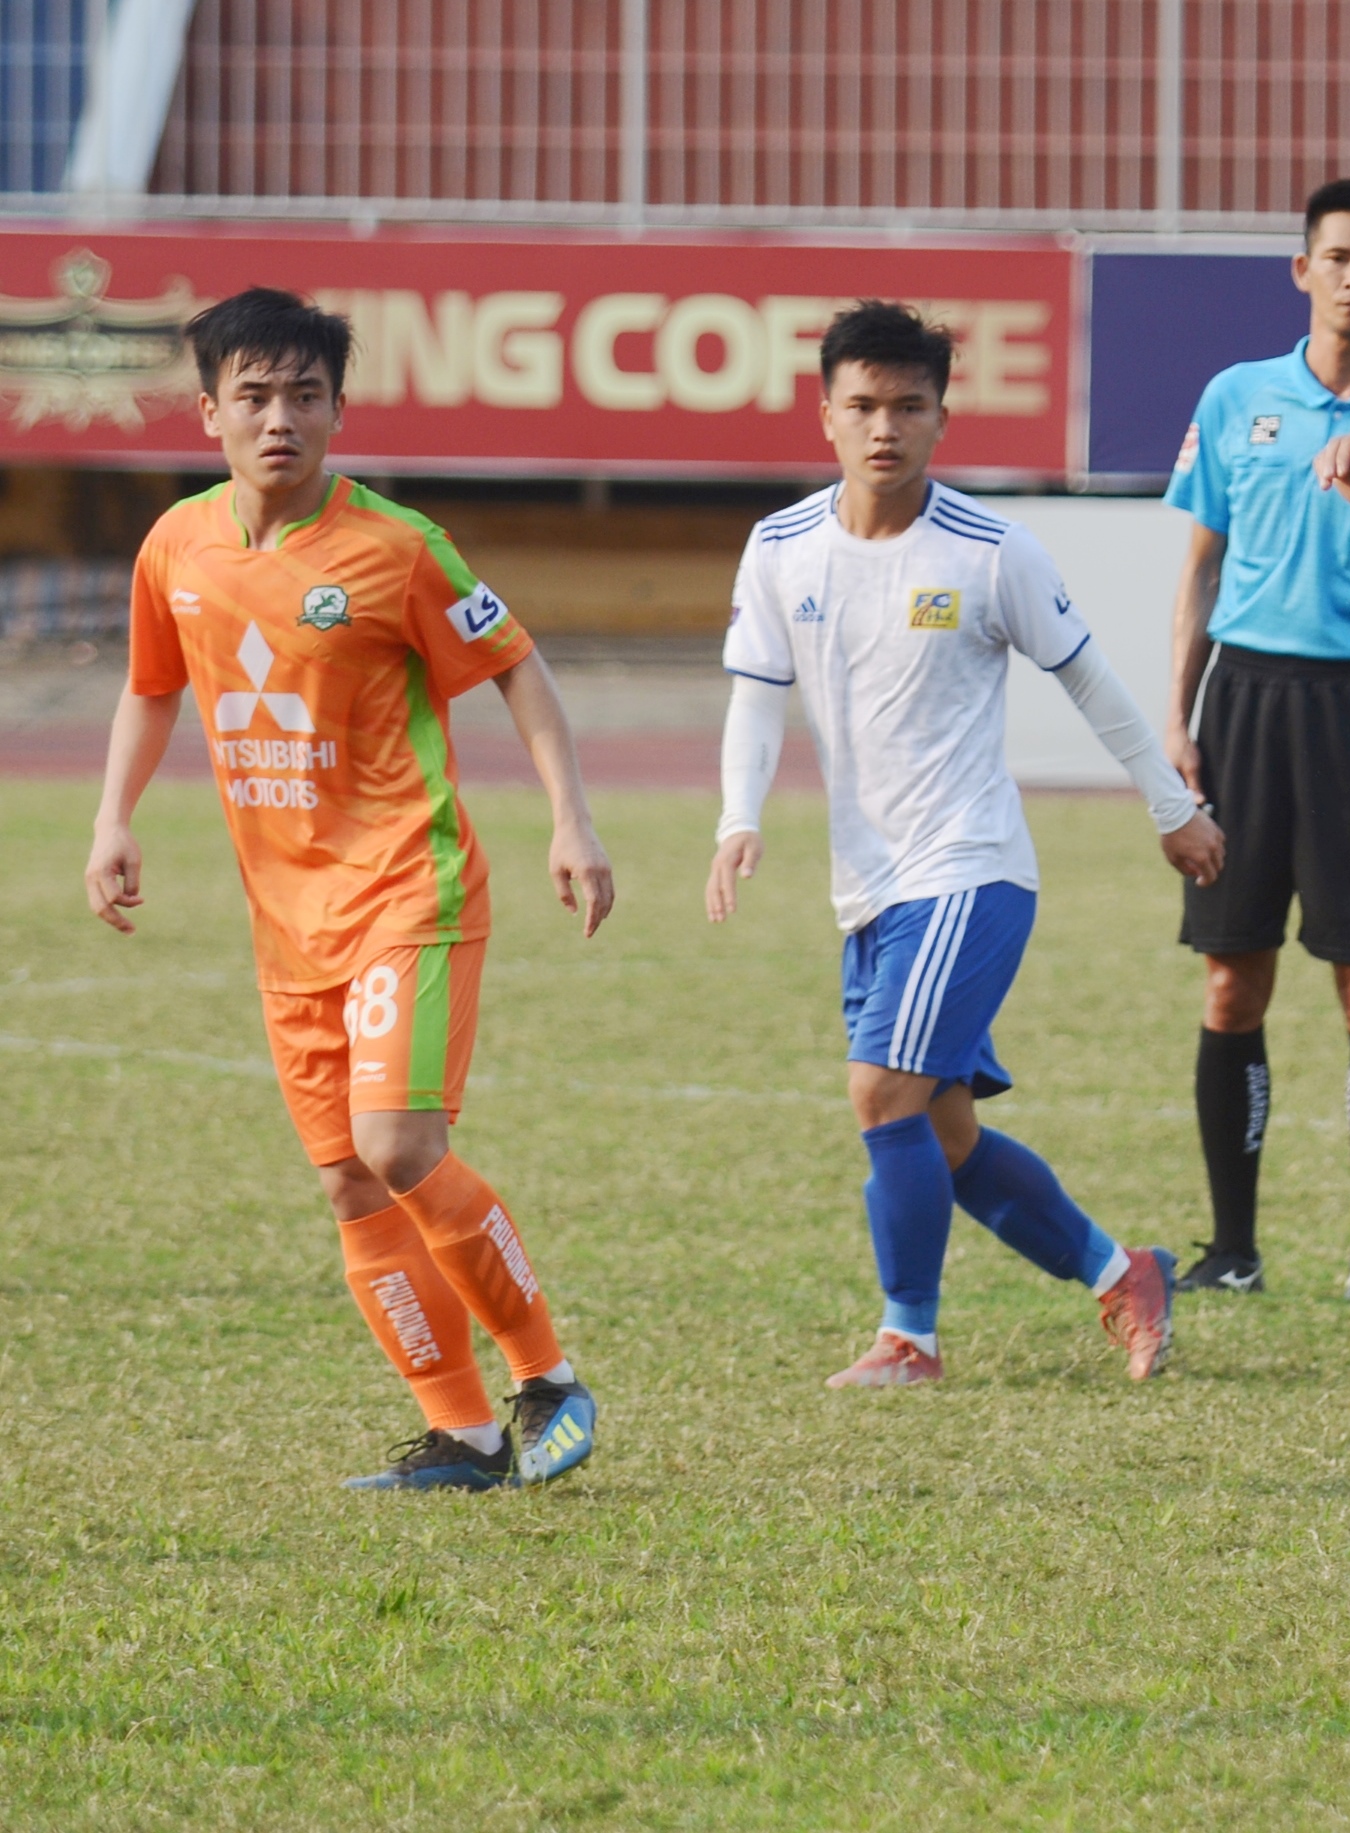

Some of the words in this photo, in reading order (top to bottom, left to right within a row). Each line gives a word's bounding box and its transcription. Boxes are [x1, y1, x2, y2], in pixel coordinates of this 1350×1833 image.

[312, 288, 567, 409] ING
[572, 293, 1052, 416] COFE
[464, 593, 500, 634] LS
[211, 737, 337, 771] TSUBISHI
[479, 1203, 515, 1251] PHU
[369, 1270, 419, 1311] PHU
[406, 1341, 444, 1369] FC
